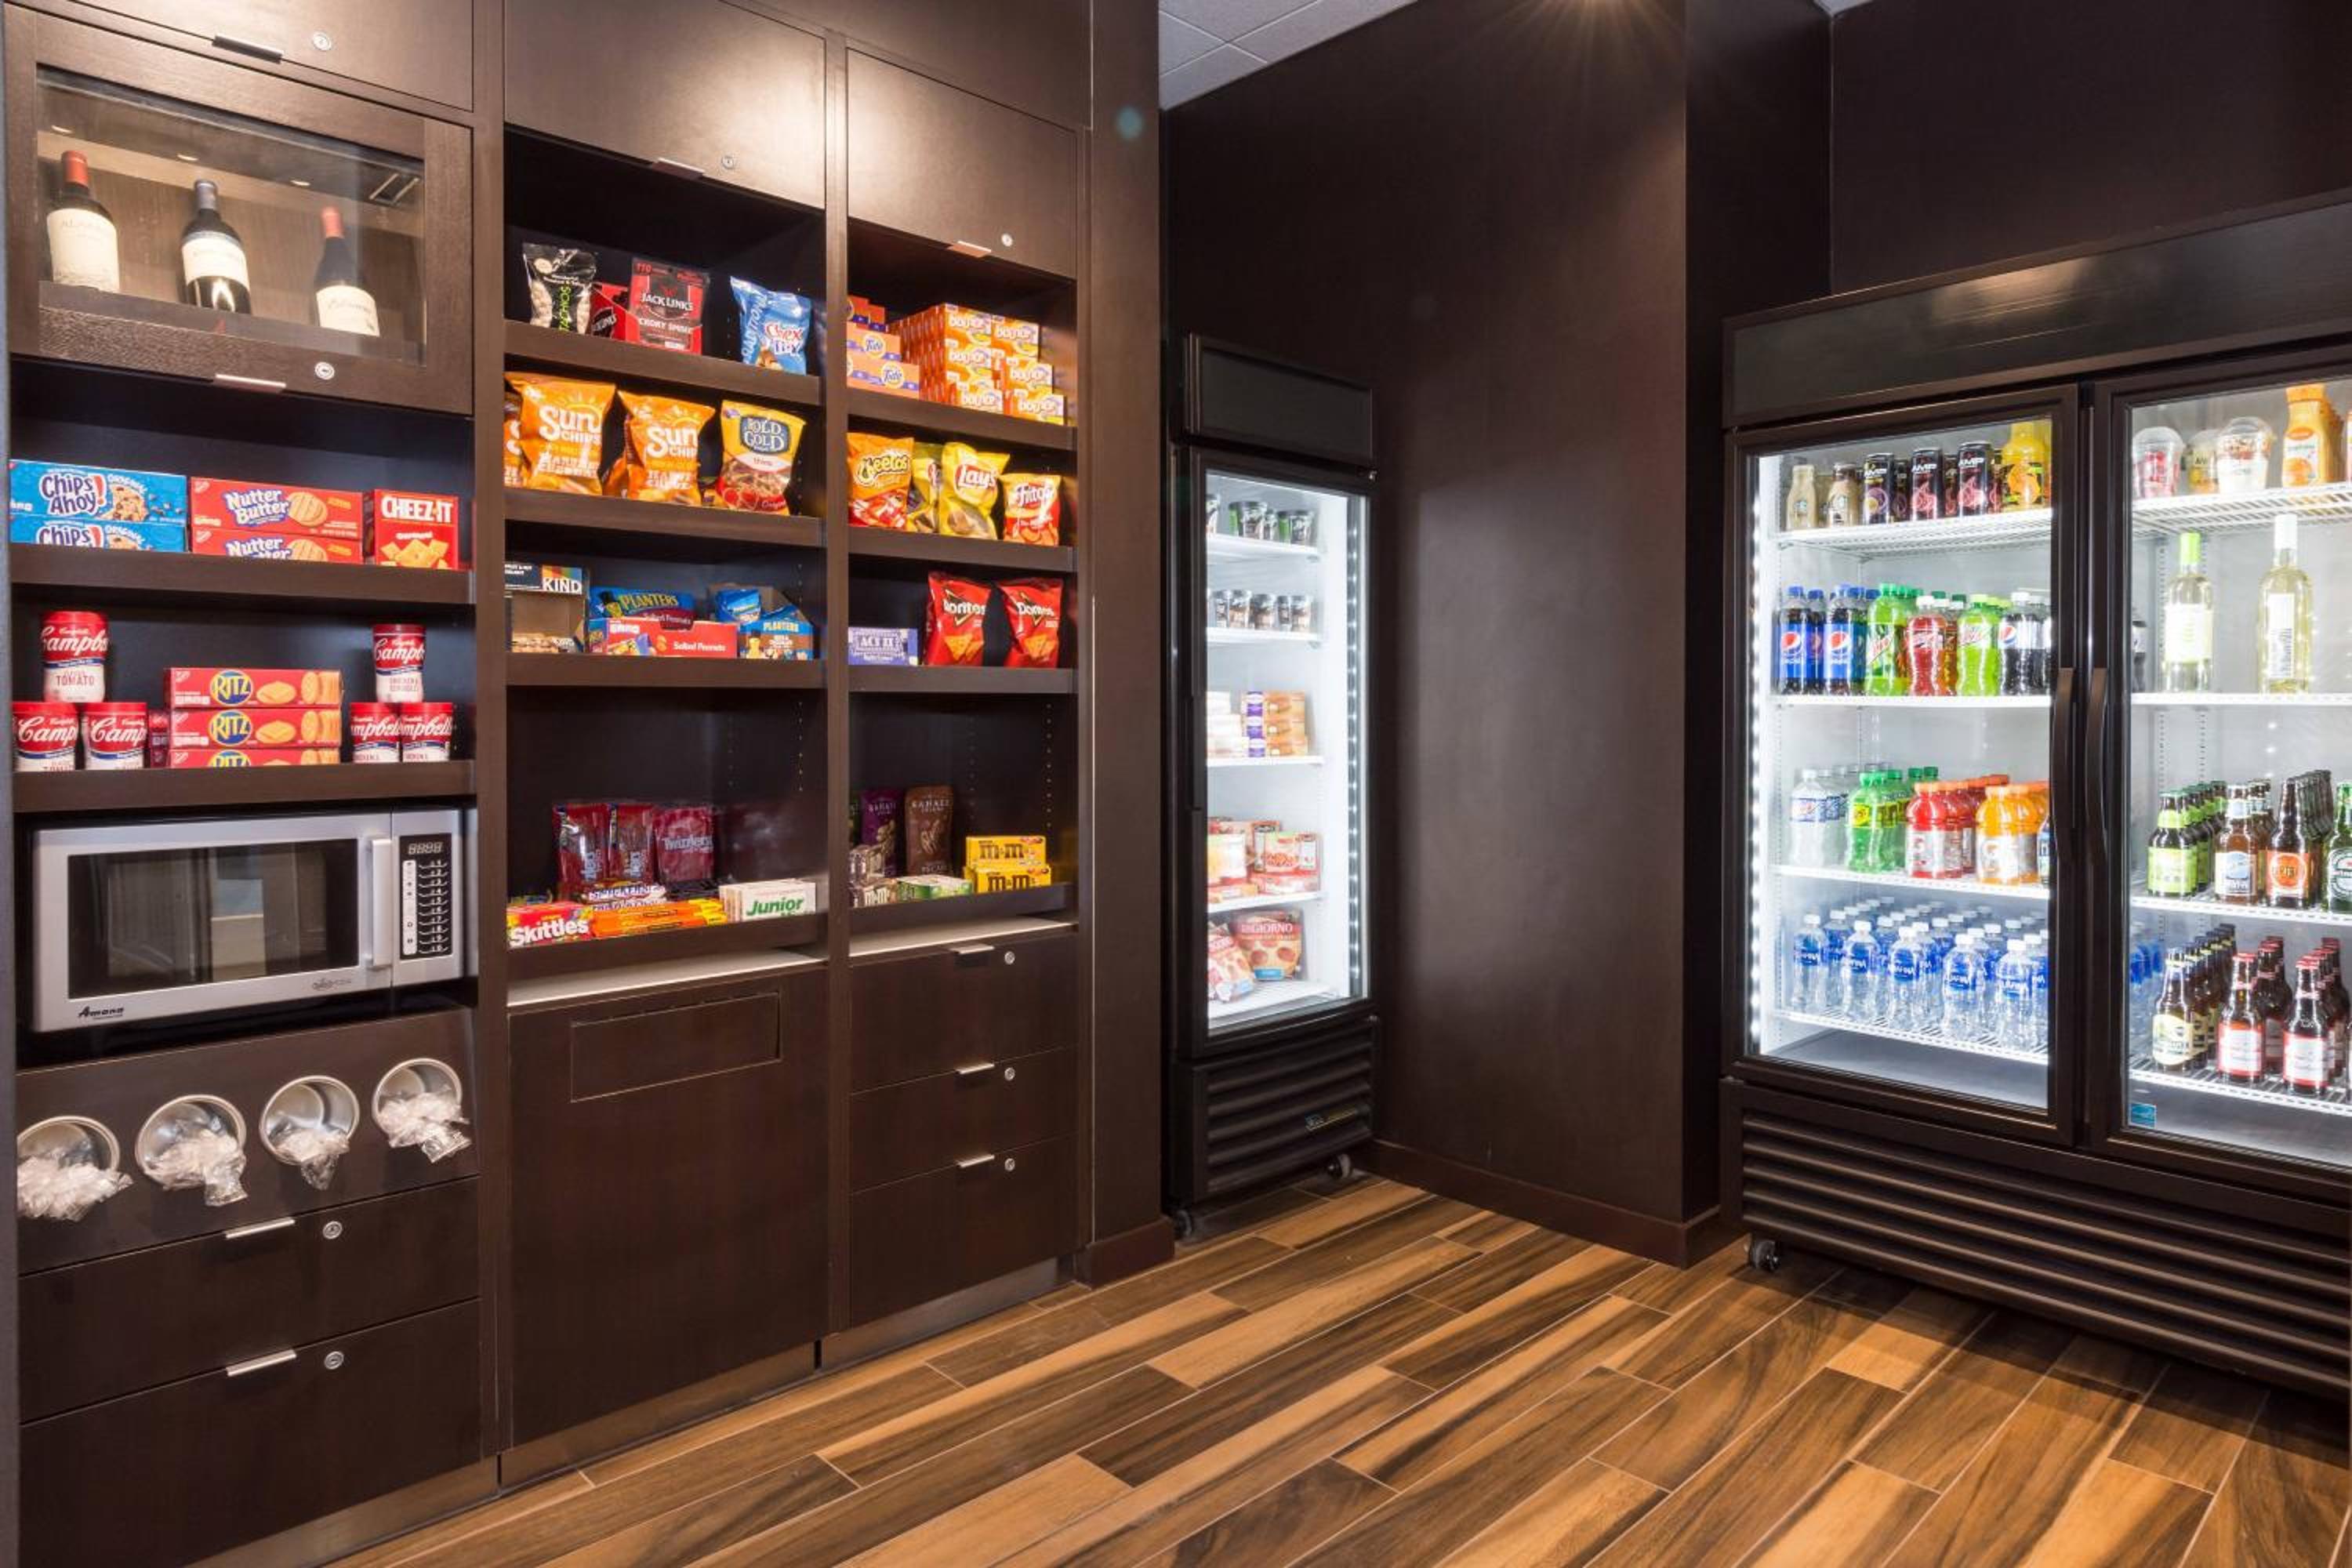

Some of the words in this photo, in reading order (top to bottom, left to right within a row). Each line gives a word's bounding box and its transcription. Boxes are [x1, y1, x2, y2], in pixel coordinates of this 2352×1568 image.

[539, 405, 601, 441] Sun
[646, 423, 699, 458] Sun
[744, 431, 784, 451] GOLD
[1911, 463, 1937, 474] AMP
[1958, 457, 1984, 468] AMP
[42, 474, 93, 499] Chips
[225, 489, 282, 511] Nutter
[236, 501, 290, 524] Butter
[226, 537, 284, 557] Nutter
[543, 577, 583, 594] KIND
[620, 592, 679, 610] PLANTERS
[56, 675, 95, 686] TOMATO
[212, 674, 252, 700] RITZ
[212, 715, 252, 740] RITZ
[746, 896, 804, 916] Junior
[510, 917, 589, 947] Skittles
[78, 1005, 124, 1017] Amana
